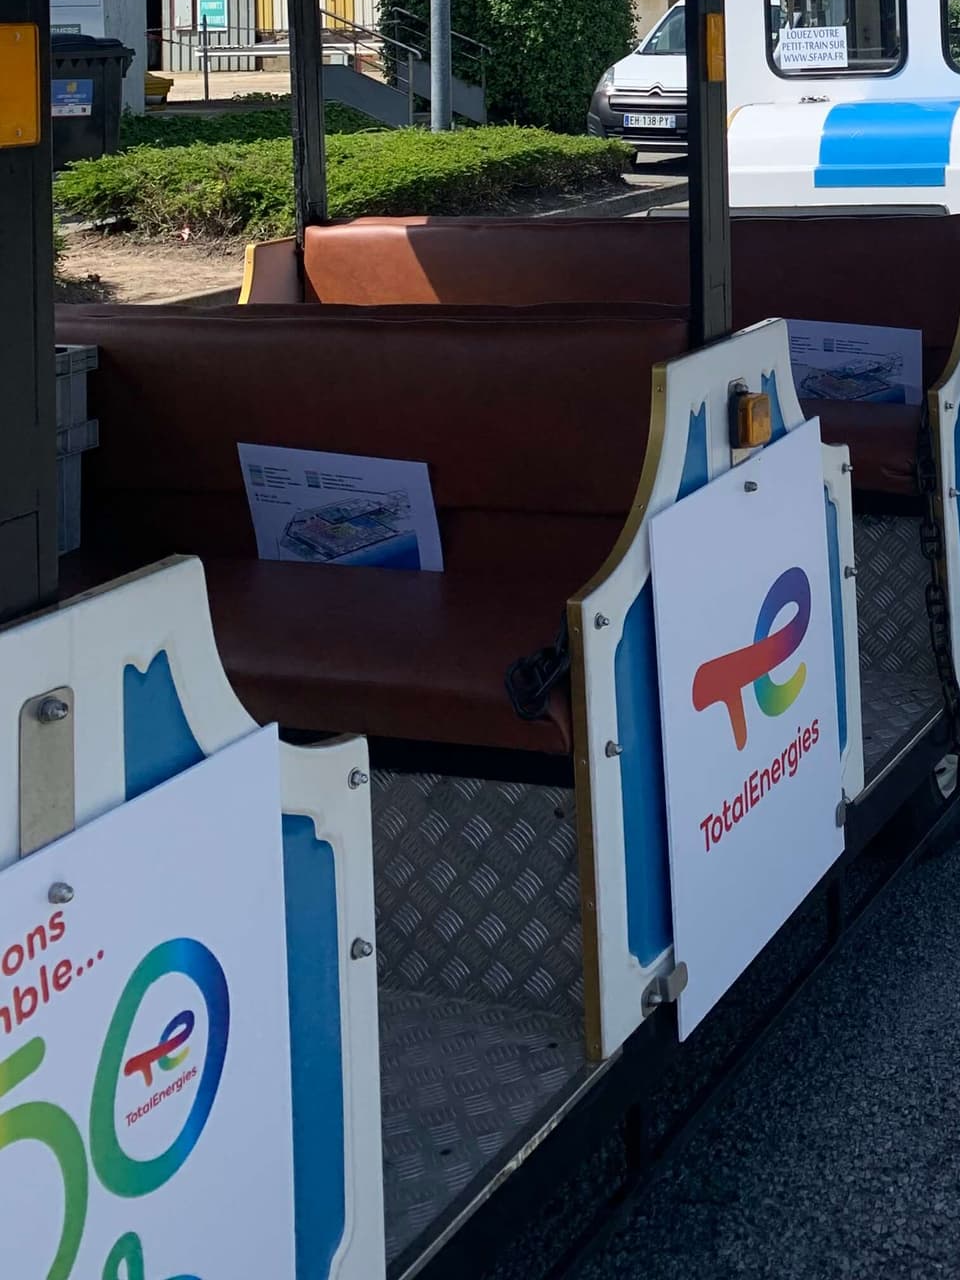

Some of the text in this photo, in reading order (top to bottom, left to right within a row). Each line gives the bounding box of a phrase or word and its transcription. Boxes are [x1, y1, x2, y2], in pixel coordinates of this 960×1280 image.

[786, 29, 840, 40] LOUEZ VOTRE
[829, 40, 845, 50] SUR
[699, 717, 820, 853] TotalEnergies
[125, 1065, 198, 1128] TotalEnergies
